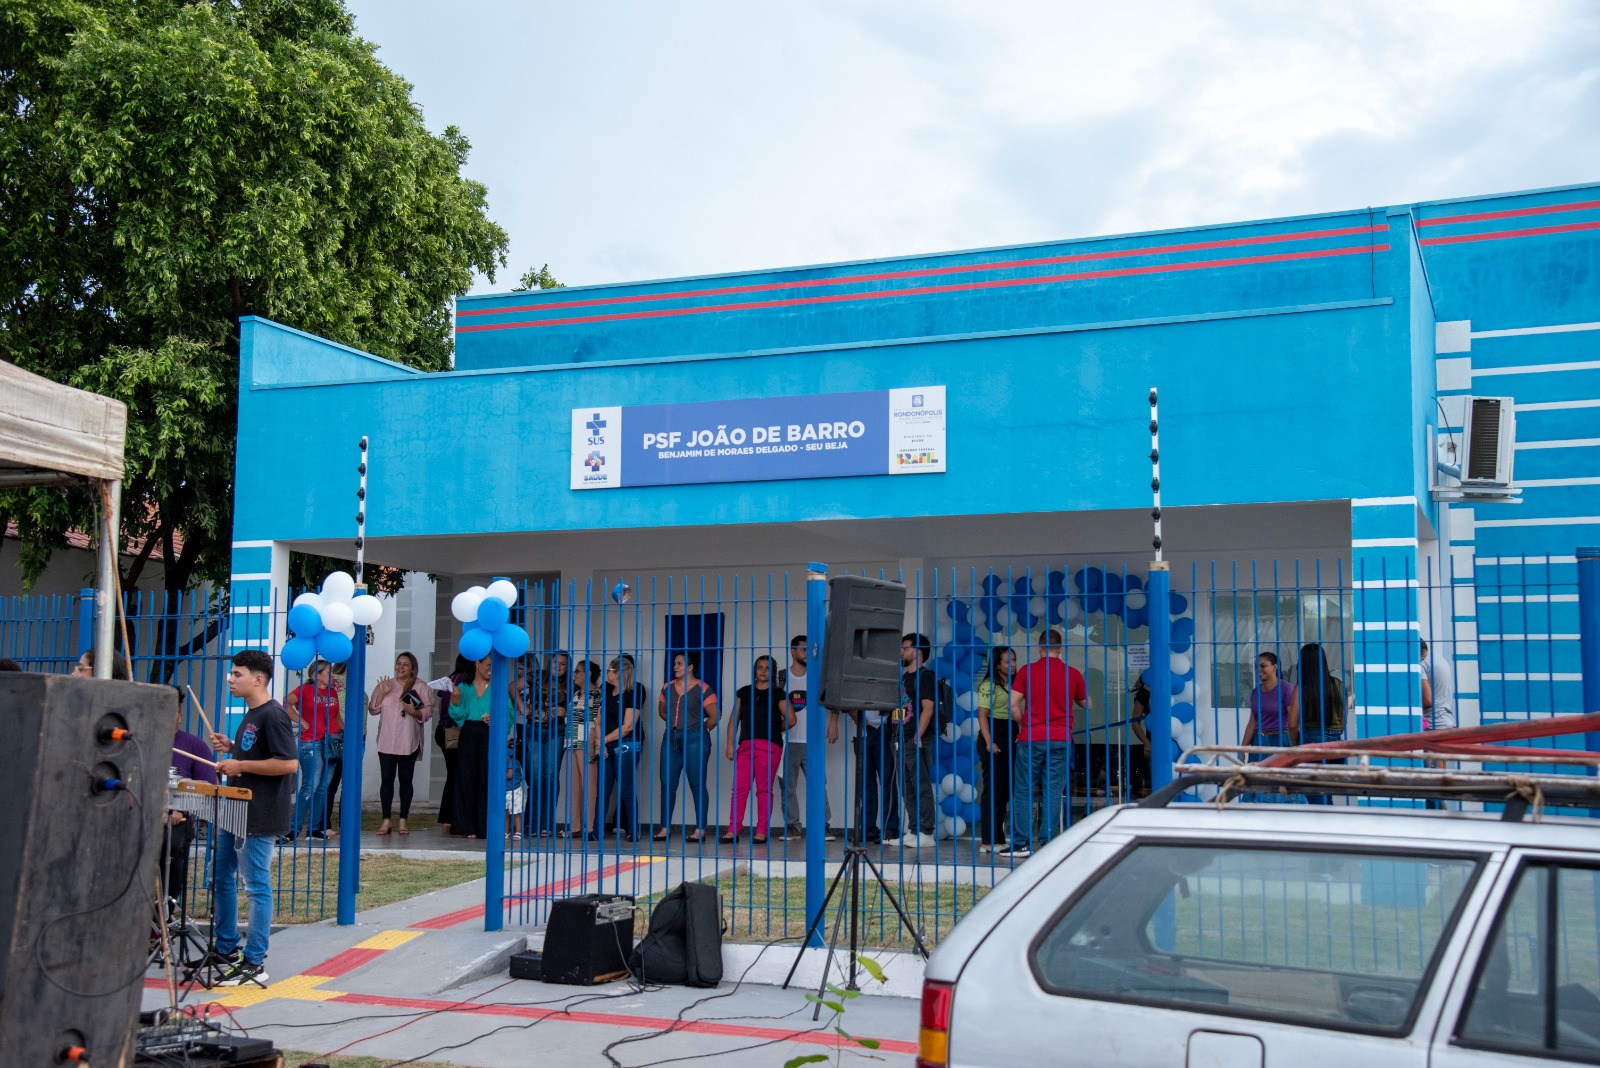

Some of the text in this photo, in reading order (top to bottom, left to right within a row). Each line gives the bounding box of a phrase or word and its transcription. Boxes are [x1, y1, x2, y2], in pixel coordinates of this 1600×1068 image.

[588, 436, 604, 446] SUS
[643, 420, 865, 450] PSF JOÃO DE BARRO
[658, 450, 702, 459] BENJAMIM
[718, 446, 754, 456] MORAES
[756, 444, 798, 454] DELGADO
[806, 443, 823, 451] SEU
[825, 442, 848, 450] BEJA
[896, 452, 938, 464] BRASIL
